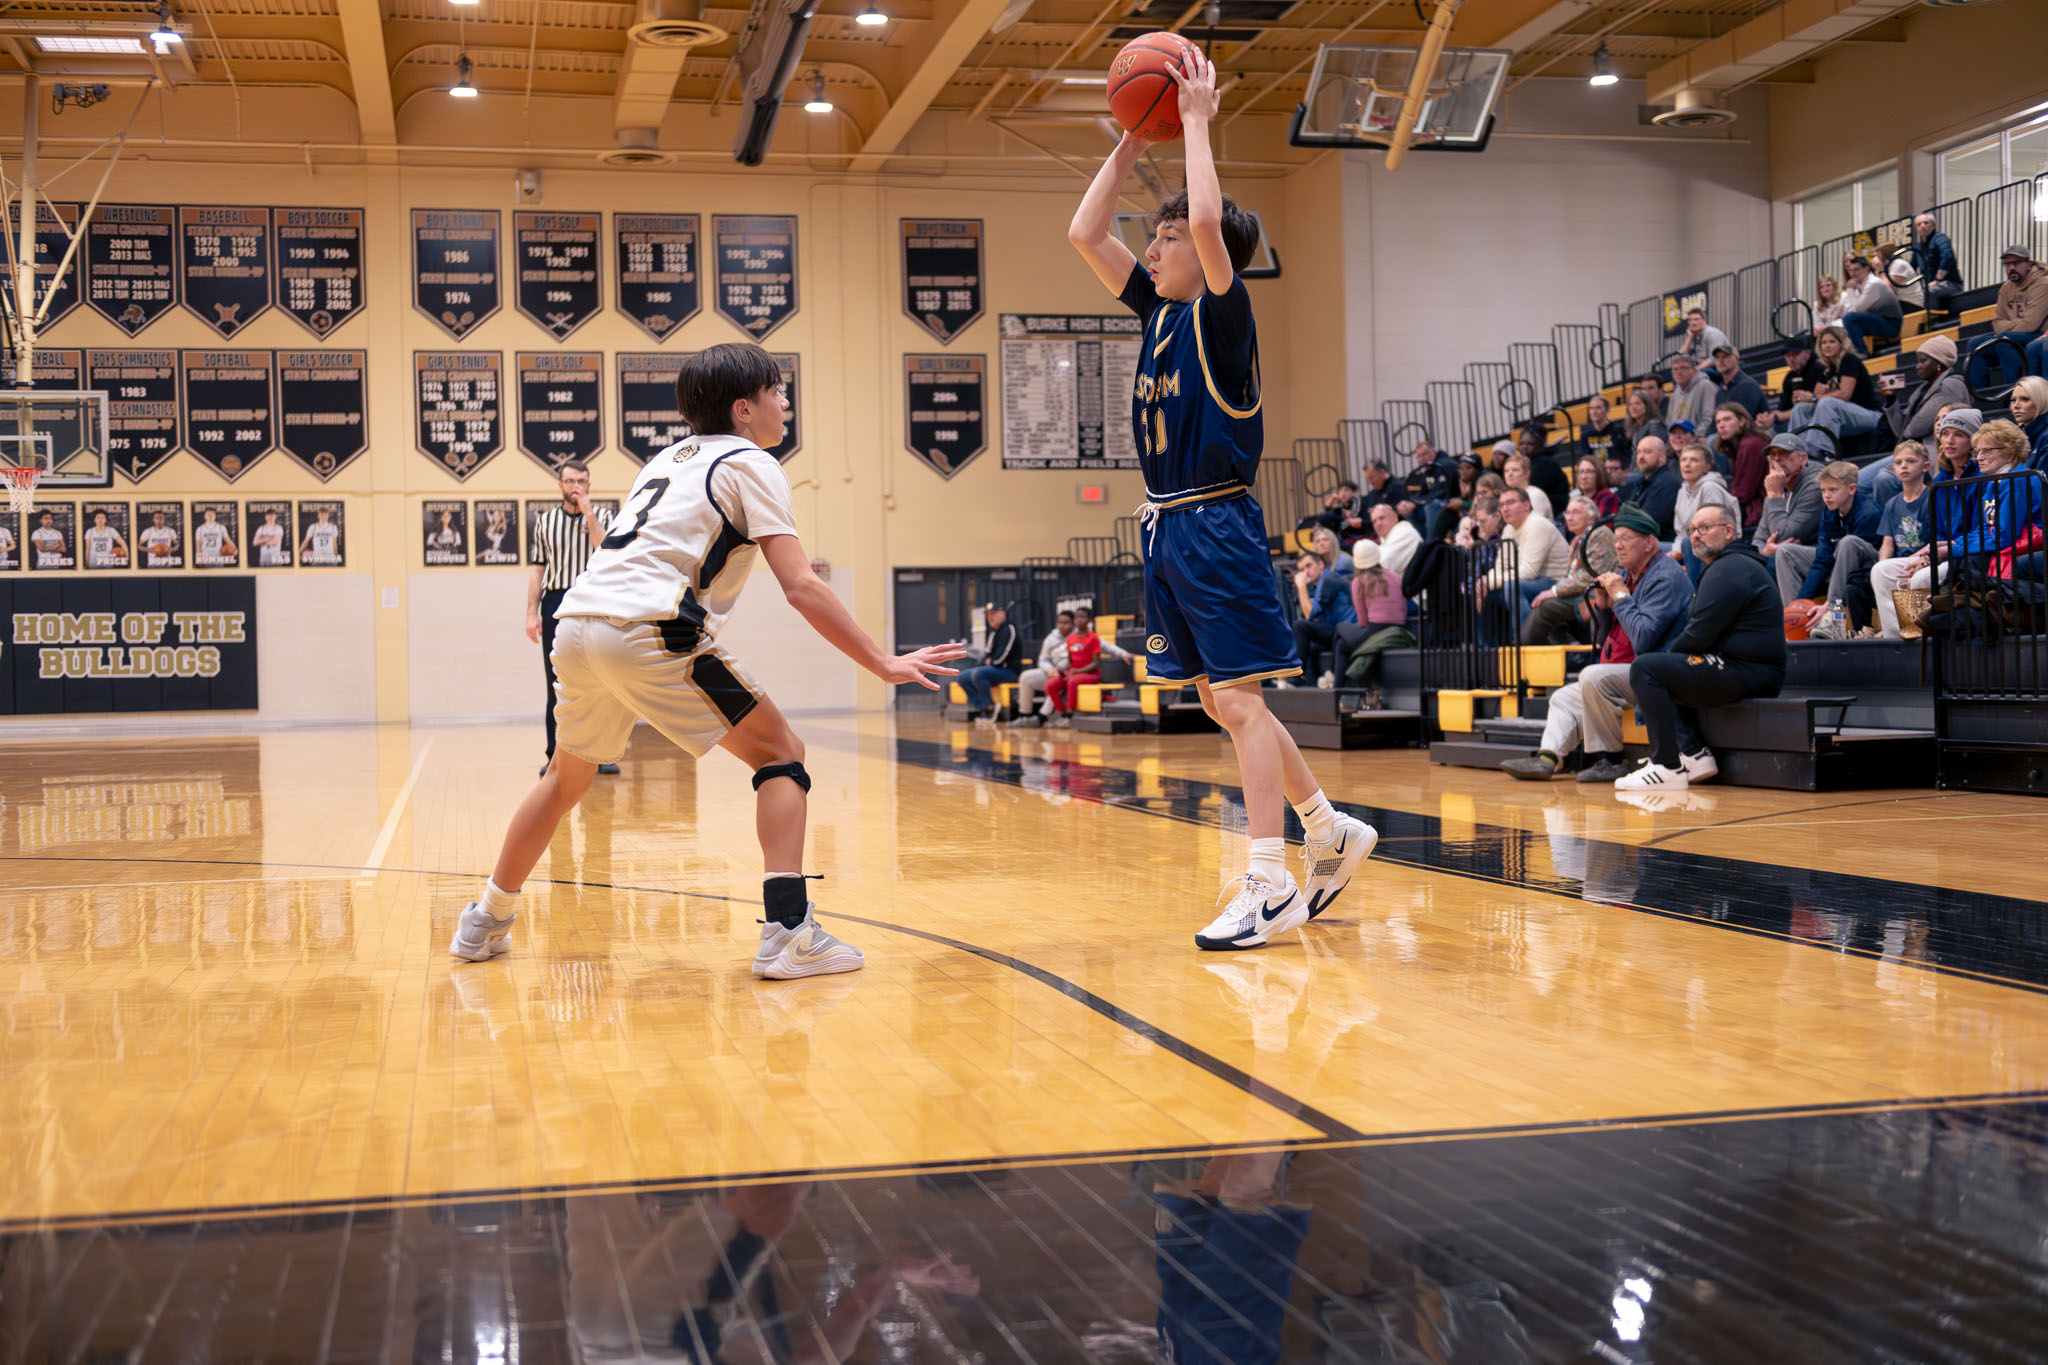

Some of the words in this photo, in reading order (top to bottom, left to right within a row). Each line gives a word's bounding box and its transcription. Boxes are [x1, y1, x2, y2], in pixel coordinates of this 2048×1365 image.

[103, 207, 159, 222] WRESTLING
[199, 210, 250, 224] BASEBALL
[288, 211, 312, 225] BOYS
[314, 211, 349, 225] SOCCER
[426, 214, 451, 228] BOYS
[453, 214, 487, 229] TENNIS
[534, 215, 558, 229] BOYS
[559, 216, 581, 230] GOLF
[110, 239, 133, 250] 2000
[194, 237, 220, 246] 1970
[231, 237, 257, 247] 1975
[110, 250, 133, 261] 2013
[194, 247, 220, 257] 1979
[231, 247, 257, 257] 1992
[289, 248, 315, 259] 1990
[323, 248, 350, 260] 1994
[444, 250, 470, 263] 1986
[528, 246, 554, 257] 1976
[564, 246, 589, 257] 1981
[213, 256, 240, 267] 2000
[546, 256, 572, 268] 1992
[93, 280, 113, 290] 2012
[132, 280, 153, 291] 2015
[289, 278, 315, 289] 1989
[326, 278, 352, 289] 1993
[93, 290, 113, 299] 2013
[289, 288, 315, 299] 1995
[326, 289, 352, 300] 1996
[445, 291, 472, 304] 1974
[546, 291, 573, 302] 1994
[289, 299, 315, 310] 1997
[326, 300, 352, 311] 2002
[1025, 317, 1068, 331] BURKE
[1069, 317, 1101, 331] HIGH
[94, 352, 116, 366] BOYS
[118, 352, 172, 367] GYMNASTICS
[204, 353, 251, 367] SOFTBALL
[289, 353, 317, 367] GIRLS
[318, 353, 354, 367] SOCCER
[427, 355, 454, 369] GIRLS
[455, 356, 488, 369] TENNIS
[535, 356, 560, 369] GIRLS
[562, 356, 585, 369] GOLF
[120, 386, 147, 398] 1983
[547, 391, 573, 402] 1982
[121, 403, 175, 417] GYMNASTICS
[430, 421, 456, 432] 1976
[465, 421, 490, 432] 1979
[199, 430, 225, 441] 1992
[235, 430, 262, 441] 2002
[549, 430, 575, 442] 1993
[109, 437, 131, 449] 975
[140, 437, 167, 449] 1976
[1004, 459, 1047, 469] TRACK
[1048, 459, 1079, 469] AND
[1080, 459, 1117, 469] FIELD
[40, 557, 74, 566] PARKS
[96, 557, 129, 566] PRICE
[12, 612, 117, 644] HOME
[121, 612, 169, 644] OF
[173, 611, 246, 643] THE
[39, 645, 221, 679] BULLDOGS
